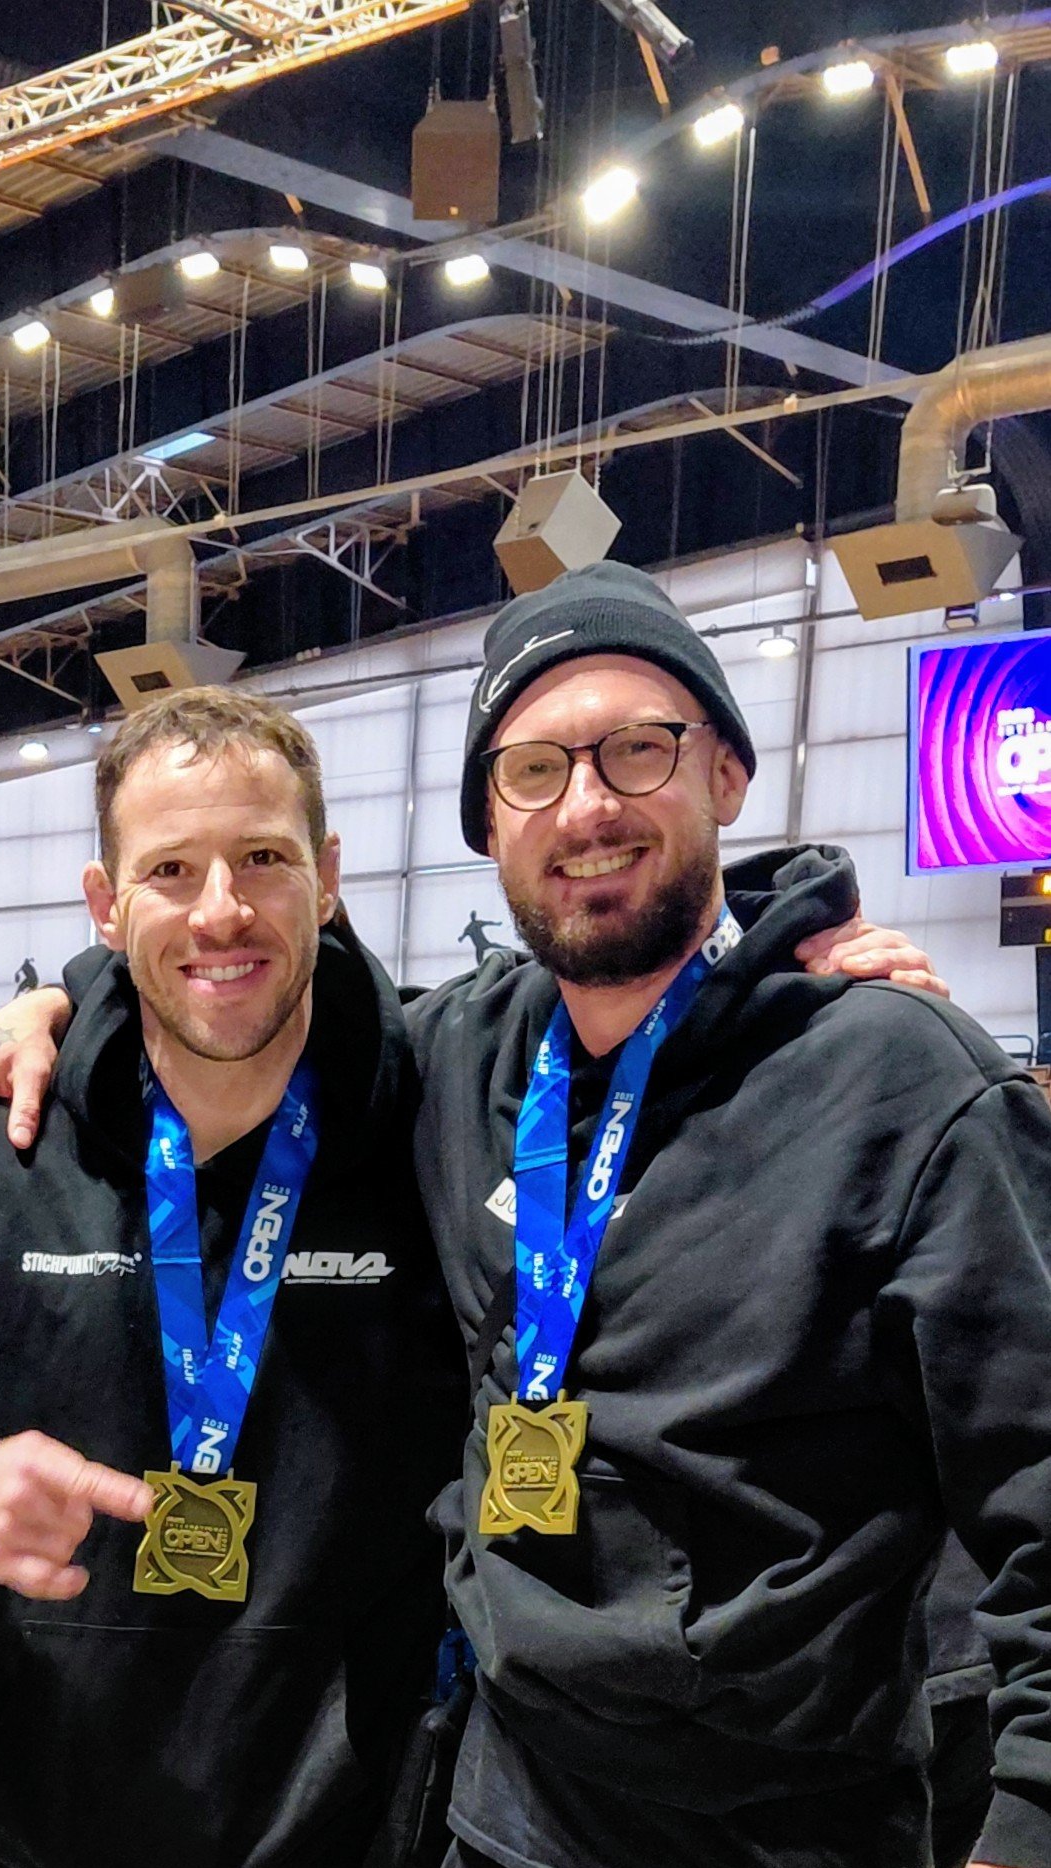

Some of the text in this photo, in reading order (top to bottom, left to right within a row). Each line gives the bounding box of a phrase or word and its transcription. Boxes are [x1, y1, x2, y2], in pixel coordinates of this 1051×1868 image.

[291, 1103, 309, 1138] IBJJF
[587, 1101, 632, 1201] OPEN
[243, 1191, 289, 1282] OPEN
[22, 1252, 94, 1275] STICHPUNKT
[281, 1251, 395, 1279] NOVA
[226, 1332, 243, 1370] IBJJF
[536, 1353, 557, 1365] 2025
[182, 1348, 195, 1385] IBJJF
[203, 1417, 229, 1431] 2025
[503, 1462, 552, 1482] OPEN
[165, 1529, 223, 1552] OPEN
